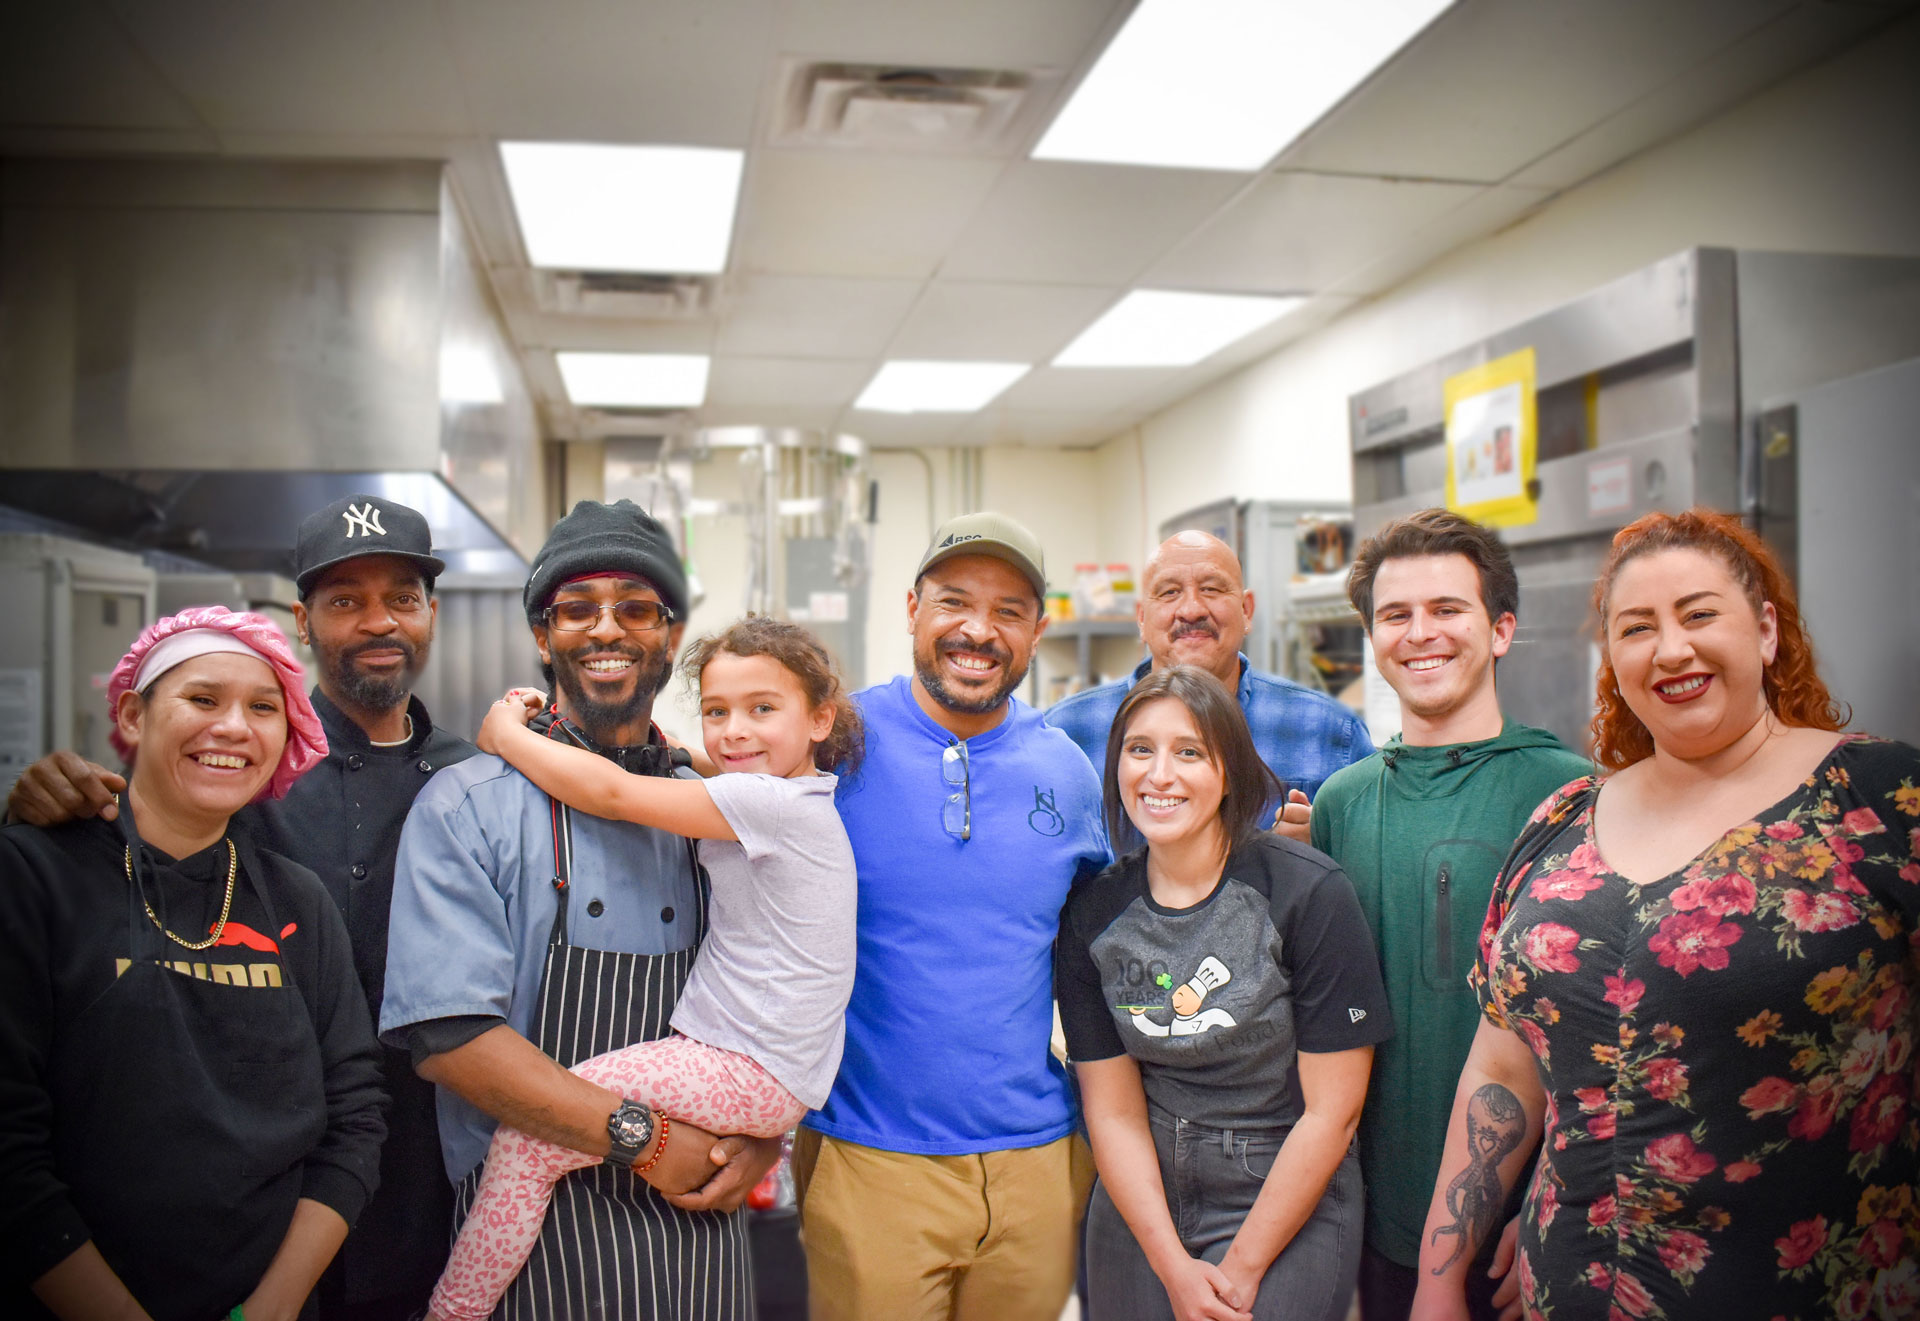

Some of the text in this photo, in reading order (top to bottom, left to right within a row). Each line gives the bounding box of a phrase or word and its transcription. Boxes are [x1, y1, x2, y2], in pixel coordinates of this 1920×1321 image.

[342, 503, 387, 538] NY
[1113, 958, 1169, 990] 100
[1115, 991, 1166, 1005] YEARS
